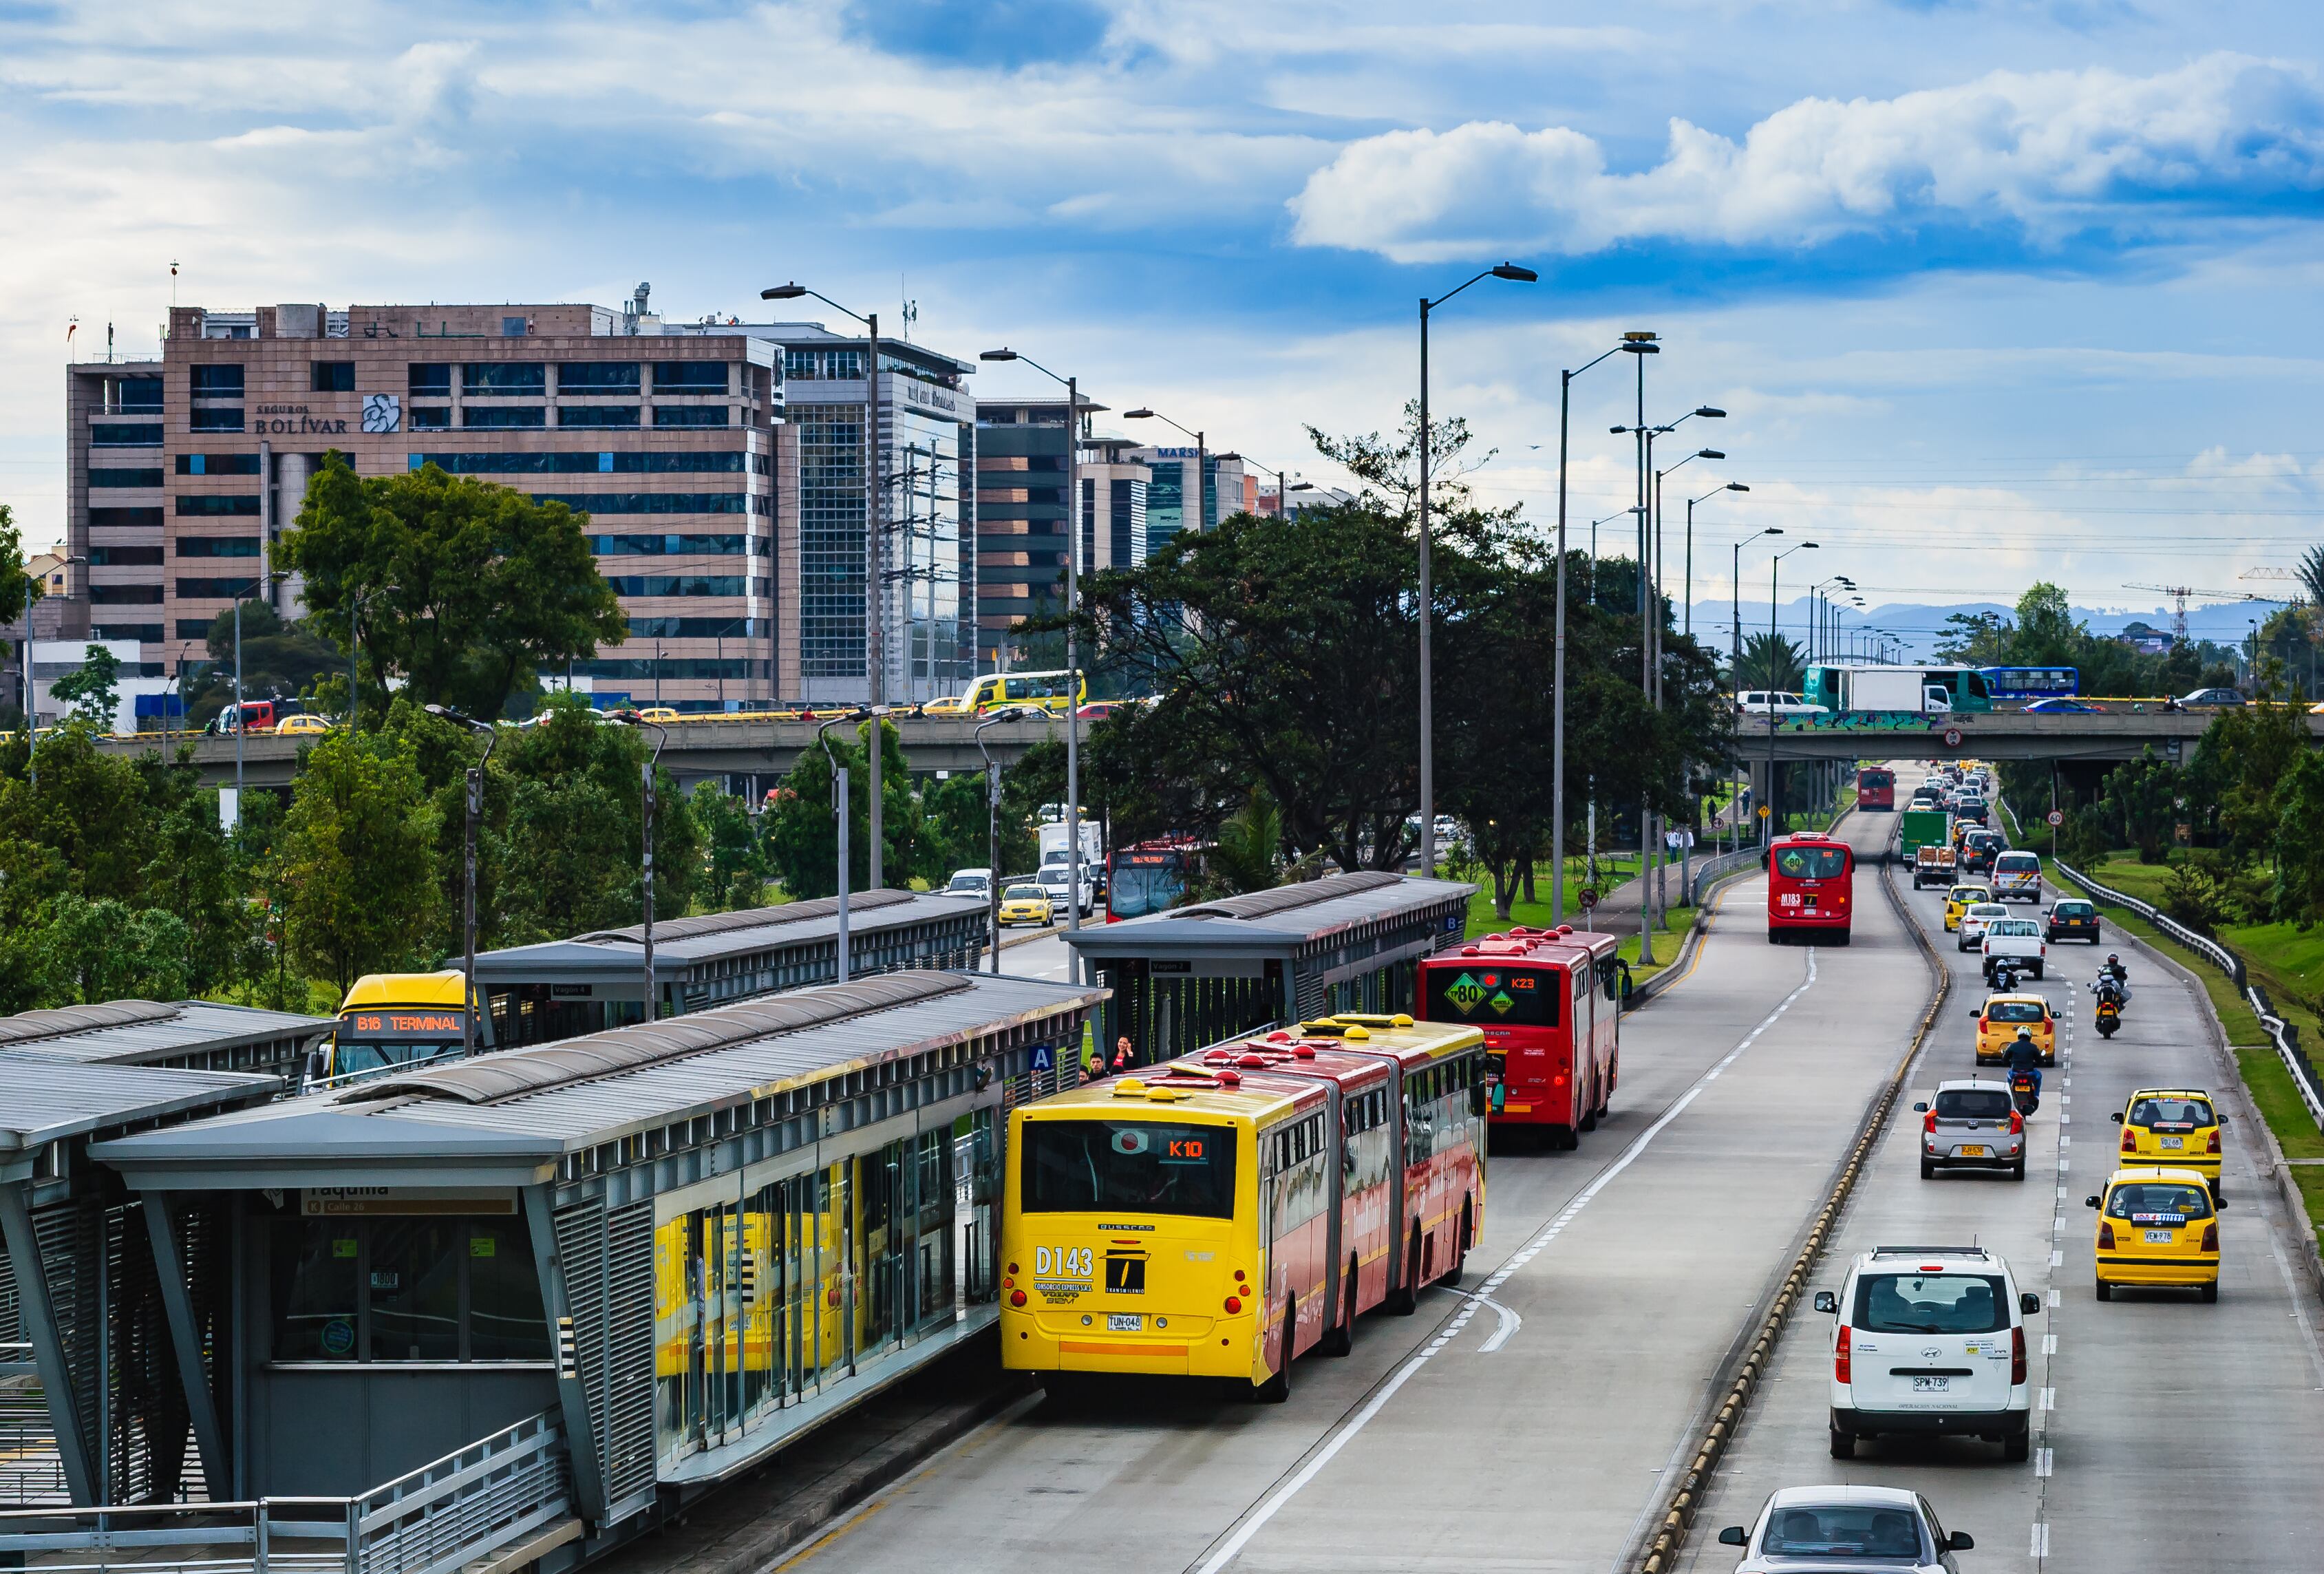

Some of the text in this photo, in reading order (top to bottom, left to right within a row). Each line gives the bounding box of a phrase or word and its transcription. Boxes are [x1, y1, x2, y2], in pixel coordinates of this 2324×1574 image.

[257, 405, 310, 414] SEGUROS
[255, 416, 347, 434] BOLÍVAR
[2049, 813, 2060, 822] 60
[1780, 893, 1801, 904] M183
[1449, 917, 1456, 930] B
[1512, 978, 1535, 989] K23
[357, 1016, 460, 1031] B16 TERMINAL
[1034, 1049, 1049, 1067] A
[1169, 1140, 1202, 1157] K10
[310, 1202, 365, 1212] K Calle 26
[1035, 1246, 1094, 1277] D143
[1034, 1283, 1060, 1291] CONSORCIO
[1061, 1283, 1080, 1292] EXPRESS
